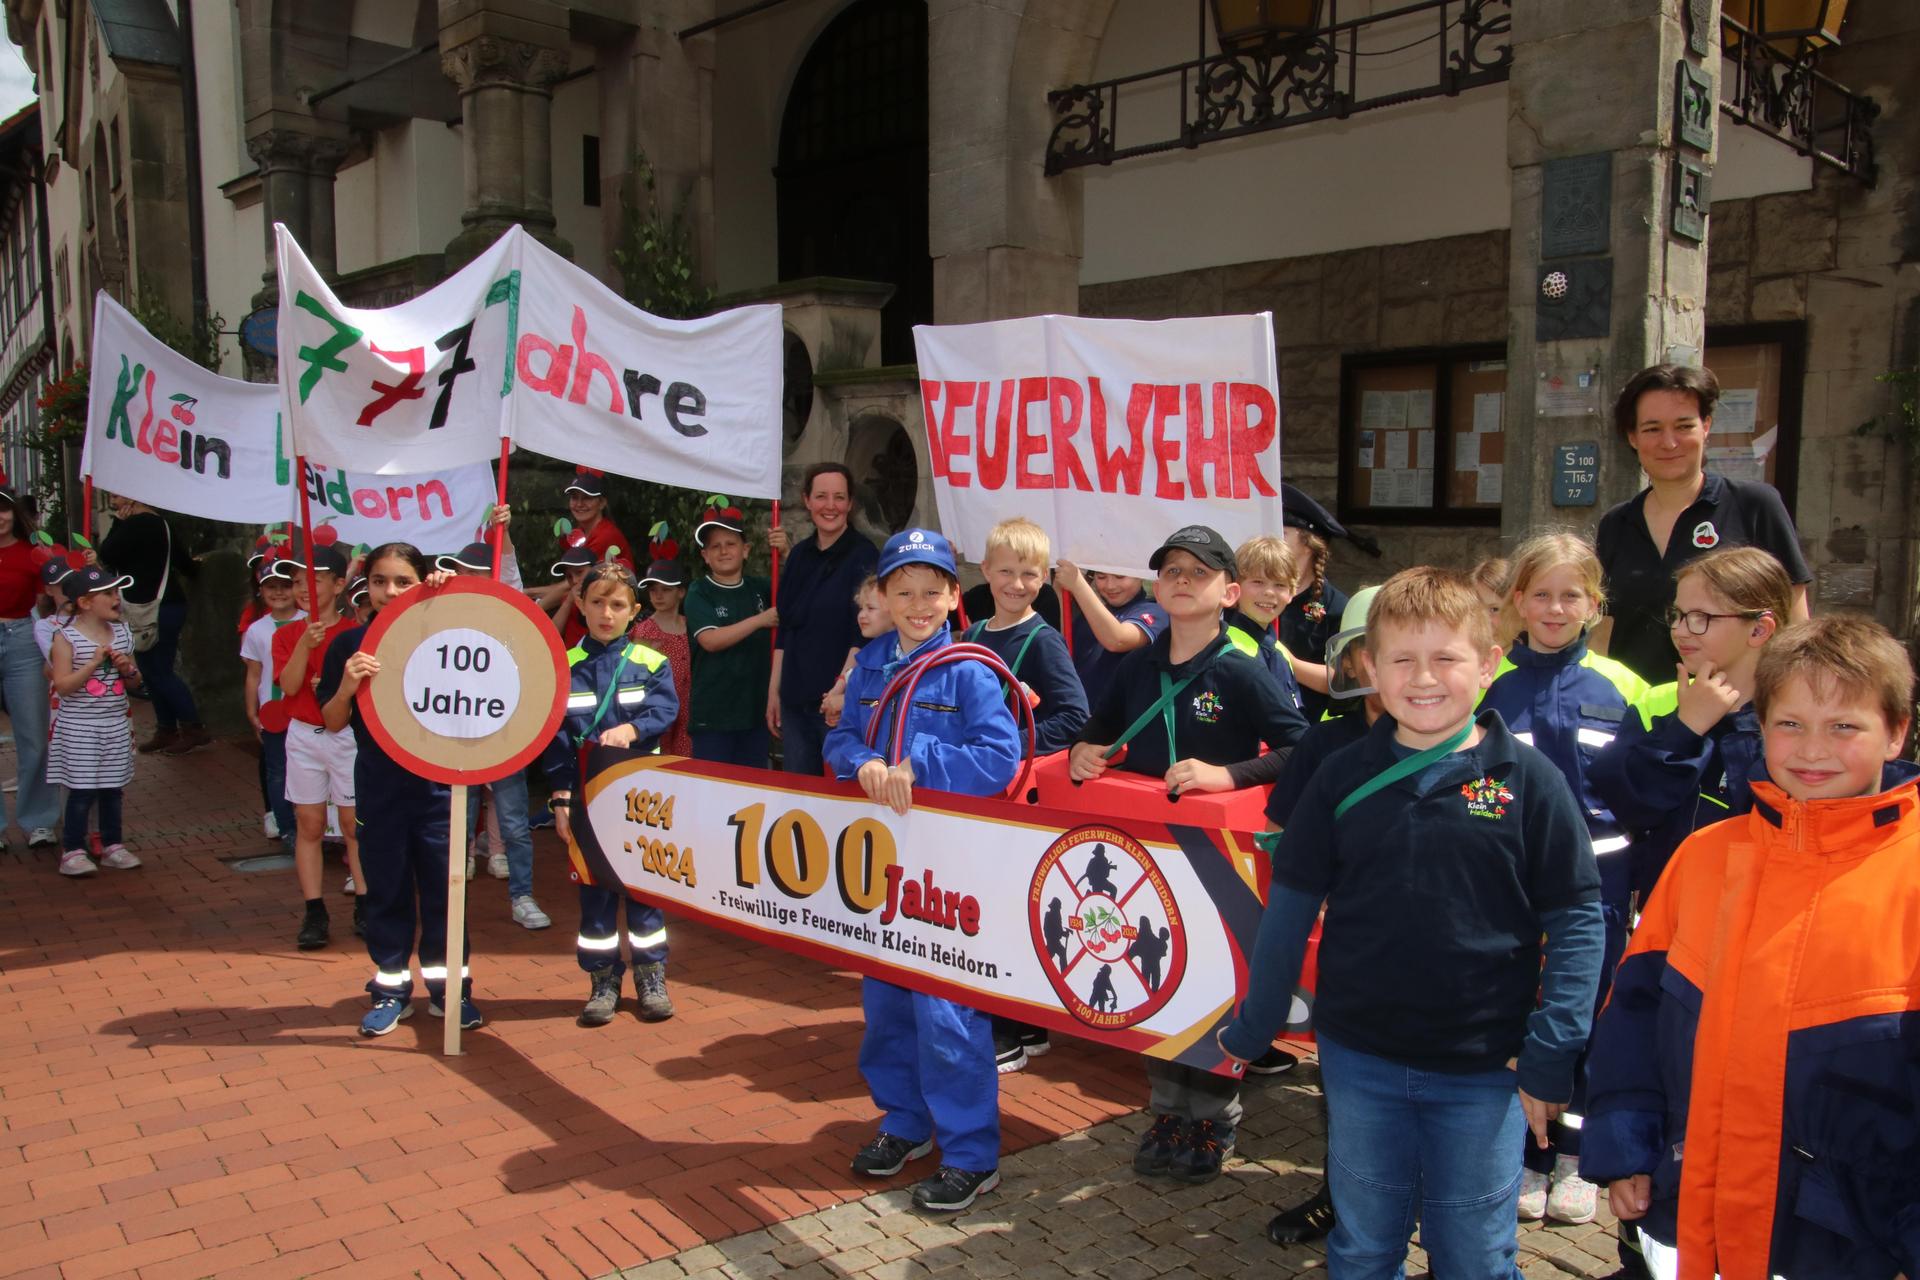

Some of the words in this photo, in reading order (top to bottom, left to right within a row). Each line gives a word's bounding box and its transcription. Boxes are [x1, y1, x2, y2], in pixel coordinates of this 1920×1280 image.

[295, 290, 476, 429] 777
[485, 269, 709, 438] Jahre
[106, 353, 231, 479] Klein
[1579, 456, 1594, 466] 100
[898, 543, 935, 553] ZURICH
[436, 644, 491, 673] 100
[412, 687, 505, 719] Jahre
[625, 787, 676, 831] 1924
[1467, 801, 1487, 810] Klein
[636, 835, 698, 888] 2024
[727, 802, 898, 915] 100
[879, 863, 981, 937] Jahre
[1032, 840, 1068, 903] FREIWILLIGE
[1068, 828, 1125, 847] FEUERWEHR
[1124, 841, 1152, 872] KLEIN
[1149, 869, 1179, 926] HEIDORN
[719, 890, 798, 926] Freiwillige
[801, 908, 877, 946] Feuerwehr
[881, 929, 927, 959] Klein
[930, 942, 998, 979] Heidorn
[1122, 927, 1137, 938] 2024
[1076, 1003, 1092, 1018] 100
[1091, 1012, 1127, 1025] JAHRE
